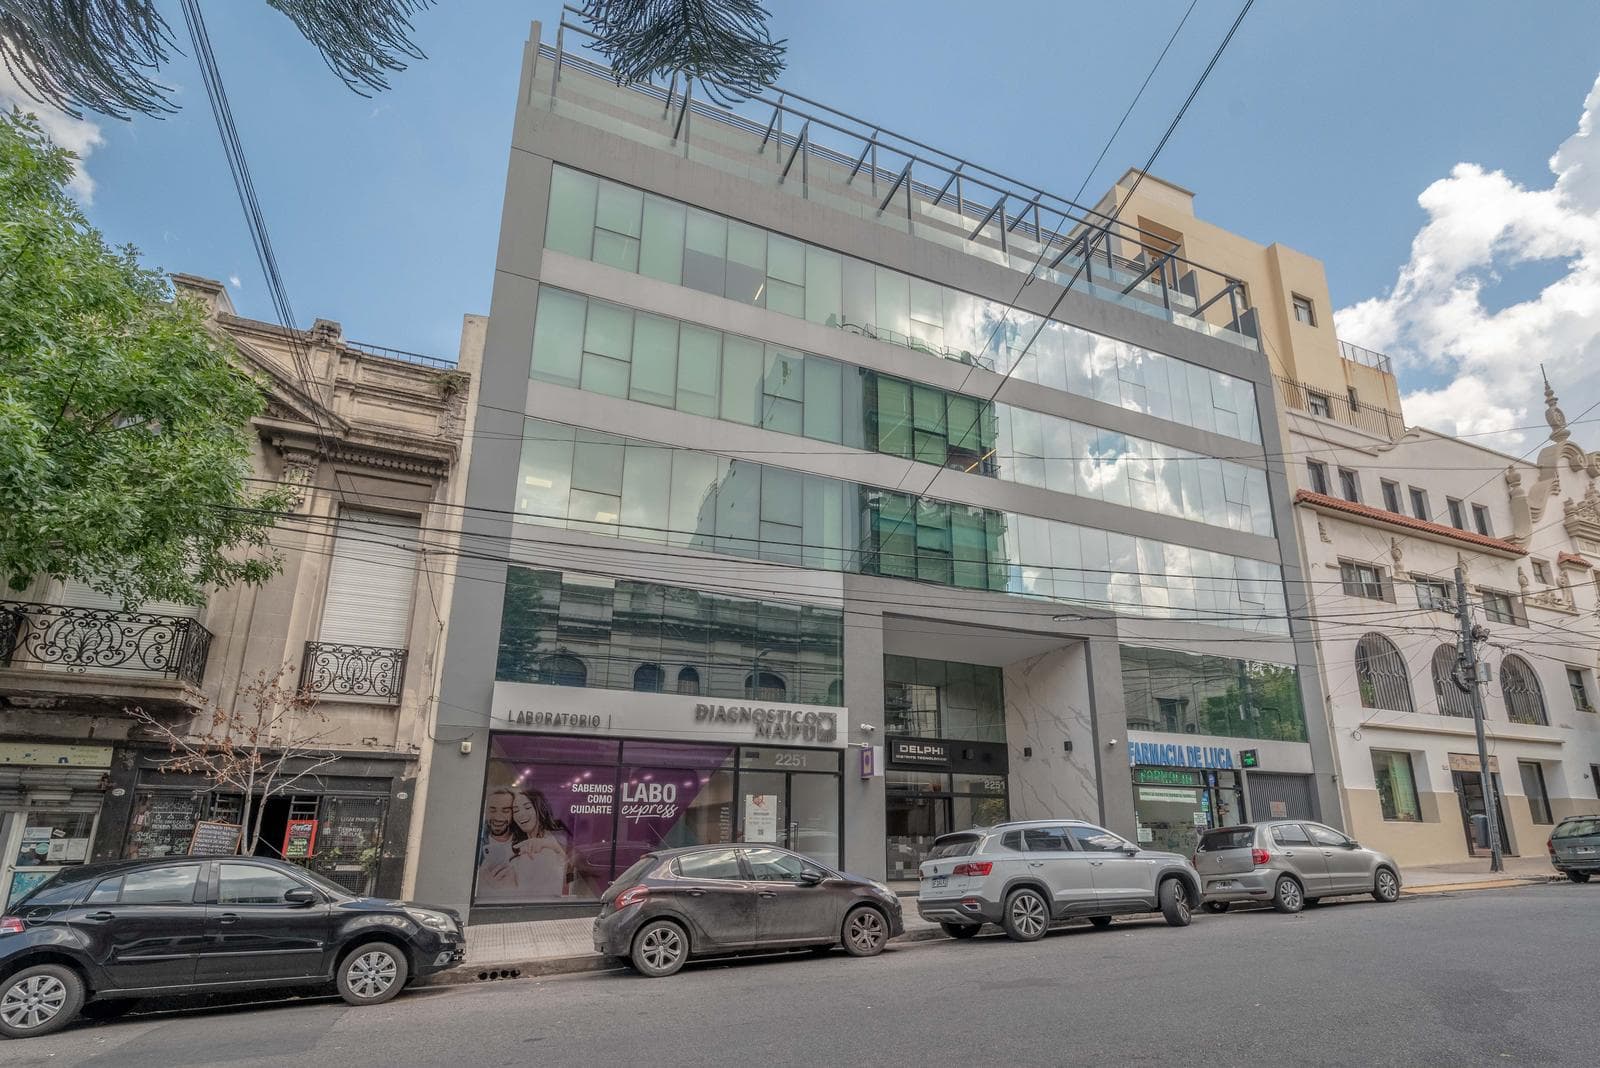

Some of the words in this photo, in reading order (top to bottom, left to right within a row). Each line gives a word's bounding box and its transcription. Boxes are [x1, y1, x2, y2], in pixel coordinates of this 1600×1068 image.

[508, 709, 601, 728] LABORATORIO
[694, 703, 818, 724] DIAGNOSTICO
[900, 744, 944, 755] DELPHI
[1128, 741, 1186, 766] FARMACIA
[1186, 745, 1201, 767] DE
[1203, 747, 1233, 769] LUCA
[775, 753, 807, 767] 2251
[572, 783, 613, 793] SABEMOS
[984, 781, 1006, 790] 2251
[587, 795, 613, 804] COMO
[622, 782, 677, 804] LABO
[570, 804, 613, 814] CUIDARTE
[621, 804, 679, 824] express
